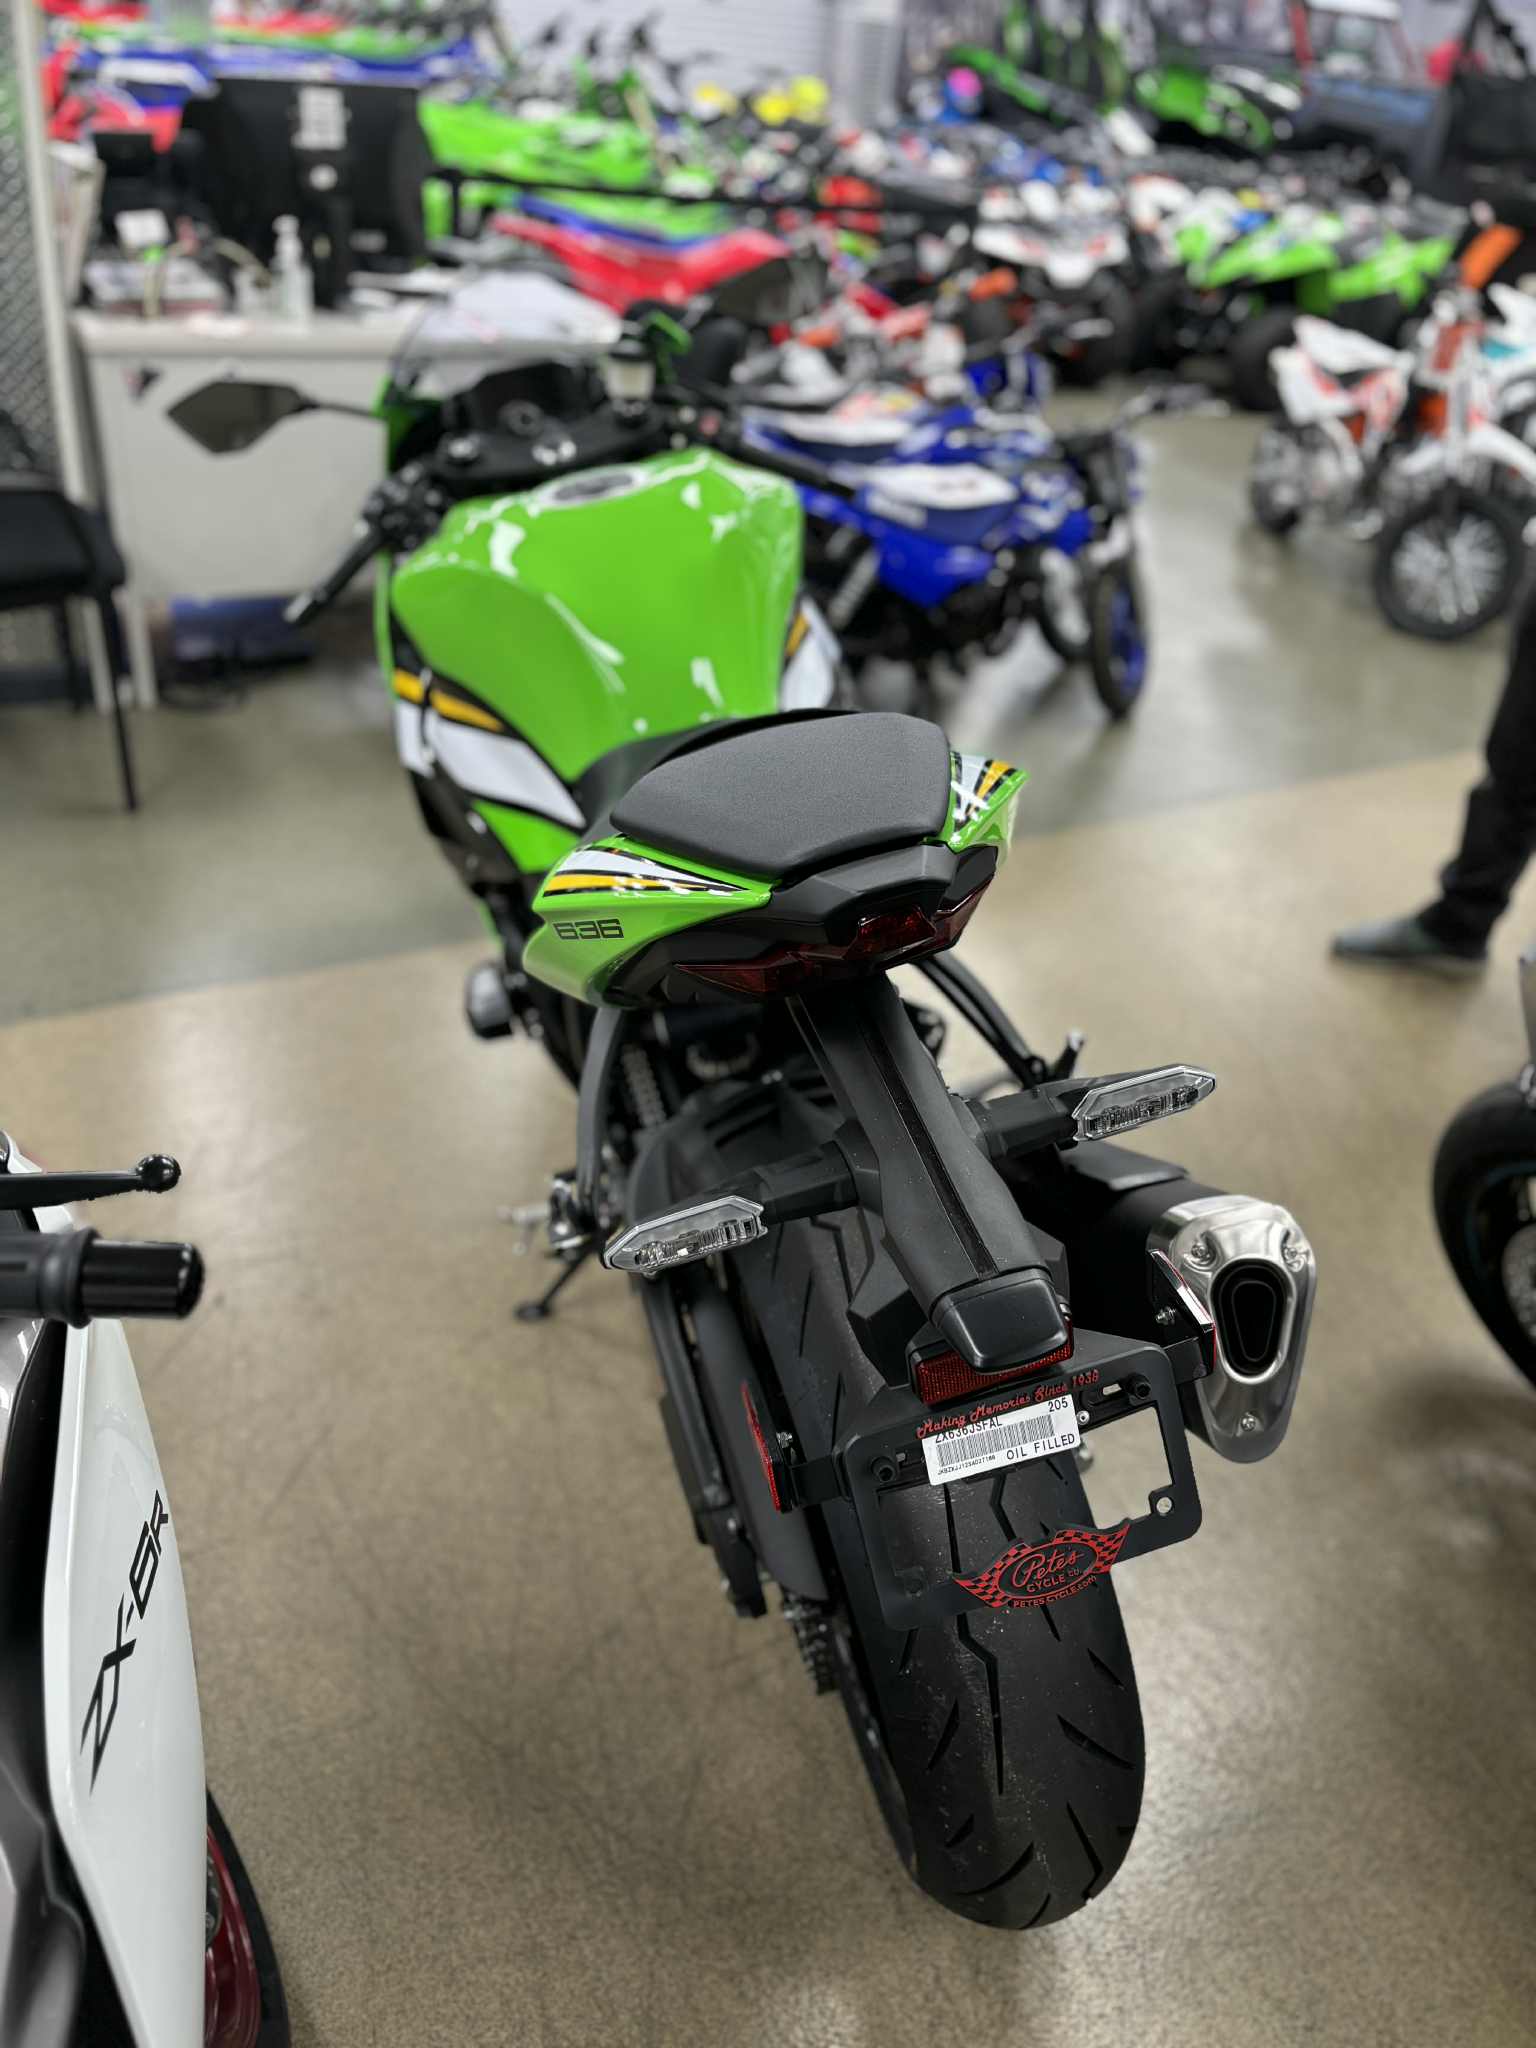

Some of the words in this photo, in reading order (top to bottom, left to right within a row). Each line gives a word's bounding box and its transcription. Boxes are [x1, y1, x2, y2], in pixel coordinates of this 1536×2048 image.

[553, 918, 624, 940] 636
[916, 1414, 967, 1439] Making
[969, 1395, 1031, 1422] Memories
[1034, 1382, 1069, 1402] Since
[1047, 1397, 1069, 1413] 205
[1006, 1448, 1028, 1461] OIL
[1034, 1432, 1076, 1455] FILLED
[1026, 1574, 1066, 1593] CYCLE
[80, 1489, 169, 1797] ZX-6R
